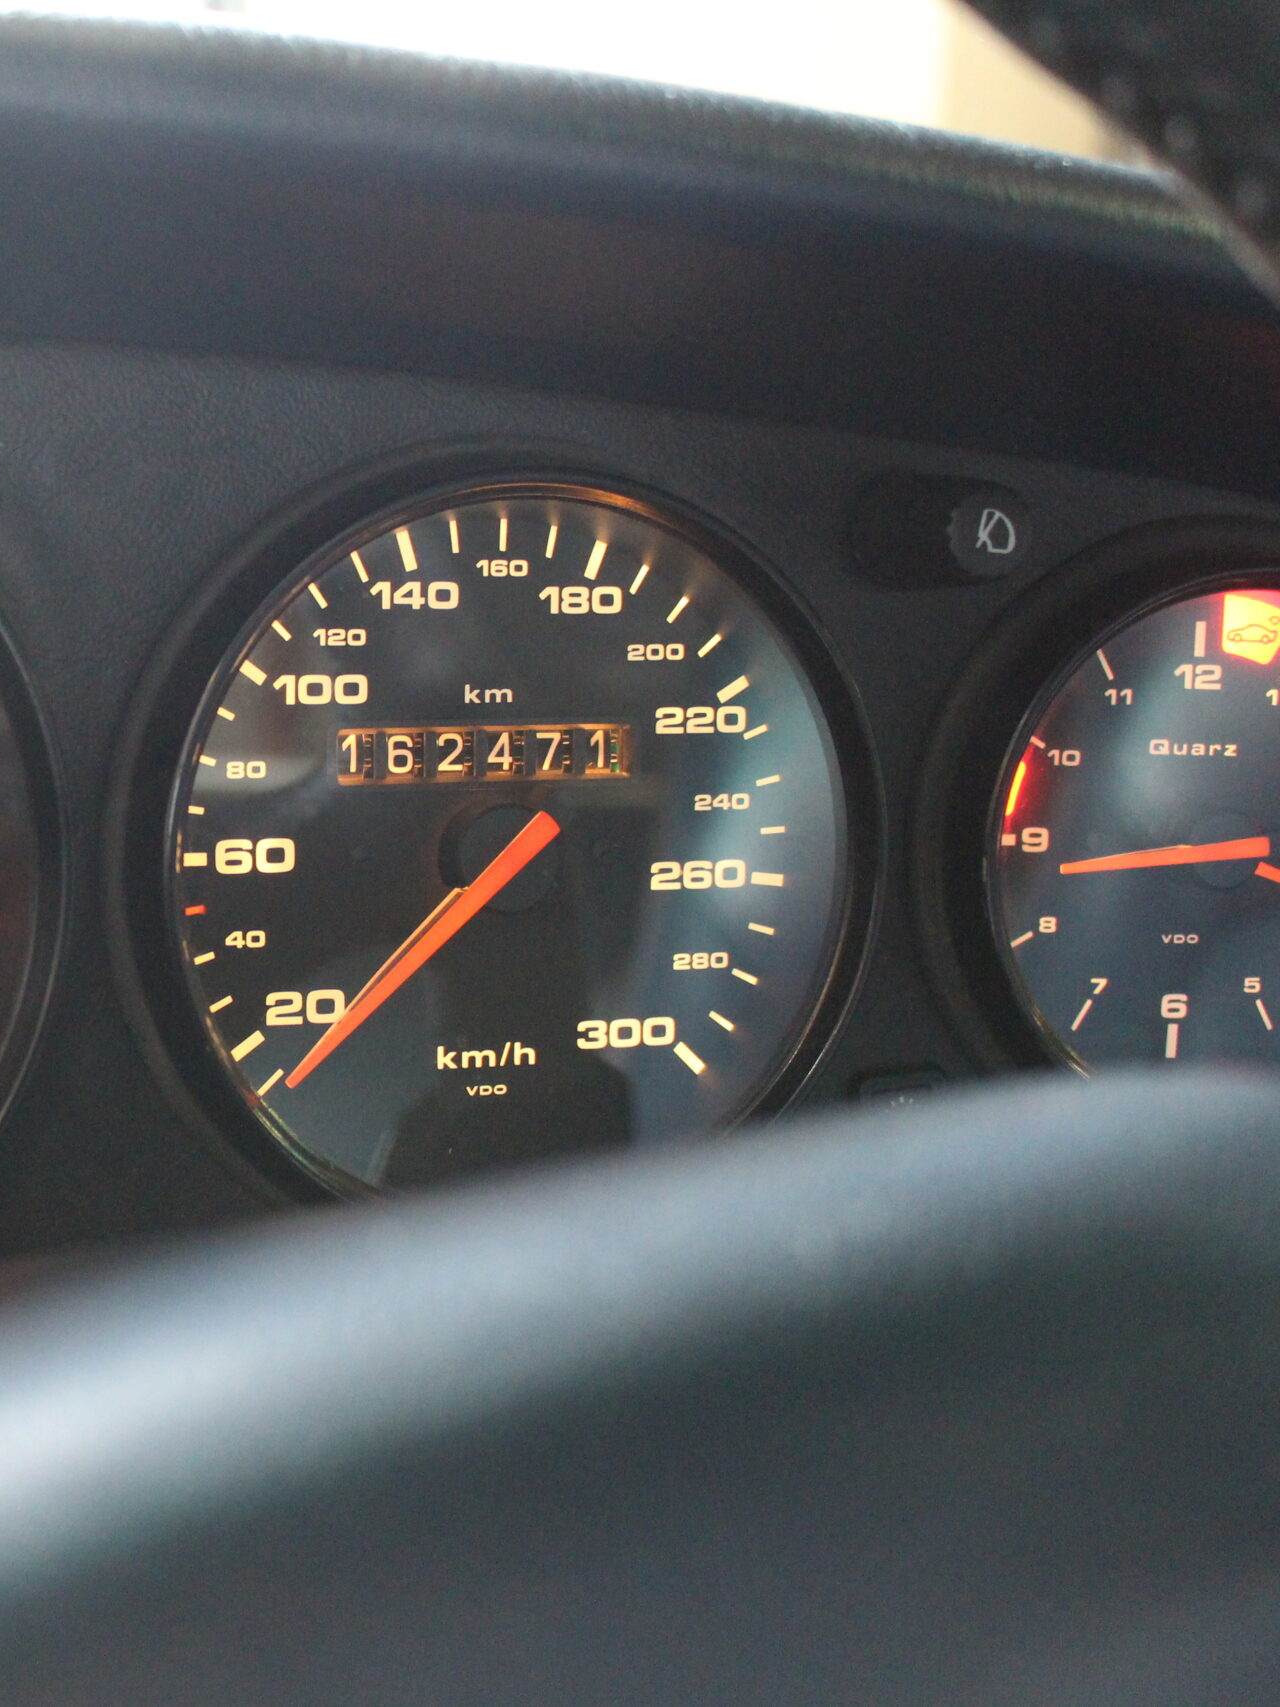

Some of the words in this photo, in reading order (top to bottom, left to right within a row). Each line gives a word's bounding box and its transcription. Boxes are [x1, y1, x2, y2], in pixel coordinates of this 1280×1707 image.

[475, 559, 529, 578] 160
[369, 581, 460, 610] 140
[538, 586, 623, 615] 180
[312, 628, 367, 647] 120
[626, 643, 686, 662] 200
[1174, 664, 1223, 690] 12
[272, 674, 369, 706] 100
[464, 684, 514, 704] km
[1104, 688, 1135, 706] 11
[654, 706, 748, 735] 220
[1148, 738, 1239, 757] Quarz
[1046, 749, 1082, 767] 10
[225, 760, 268, 780] 80
[693, 793, 751, 812] 240
[1021, 826, 1050, 853] 9
[214, 837, 296, 875] 60
[650, 859, 747, 891] 260
[1038, 916, 1058, 934] 8
[224, 930, 267, 949] 40
[1161, 934, 1200, 944] VDO
[672, 952, 730, 971] 280
[1090, 977, 1109, 995] 7
[1243, 977, 1262, 994] 5
[265, 989, 346, 1026] 20
[1160, 993, 1189, 1020] 6
[576, 1016, 676, 1050] 300
[436, 1042, 537, 1070] km/h
[466, 1084, 508, 1097] VDO
